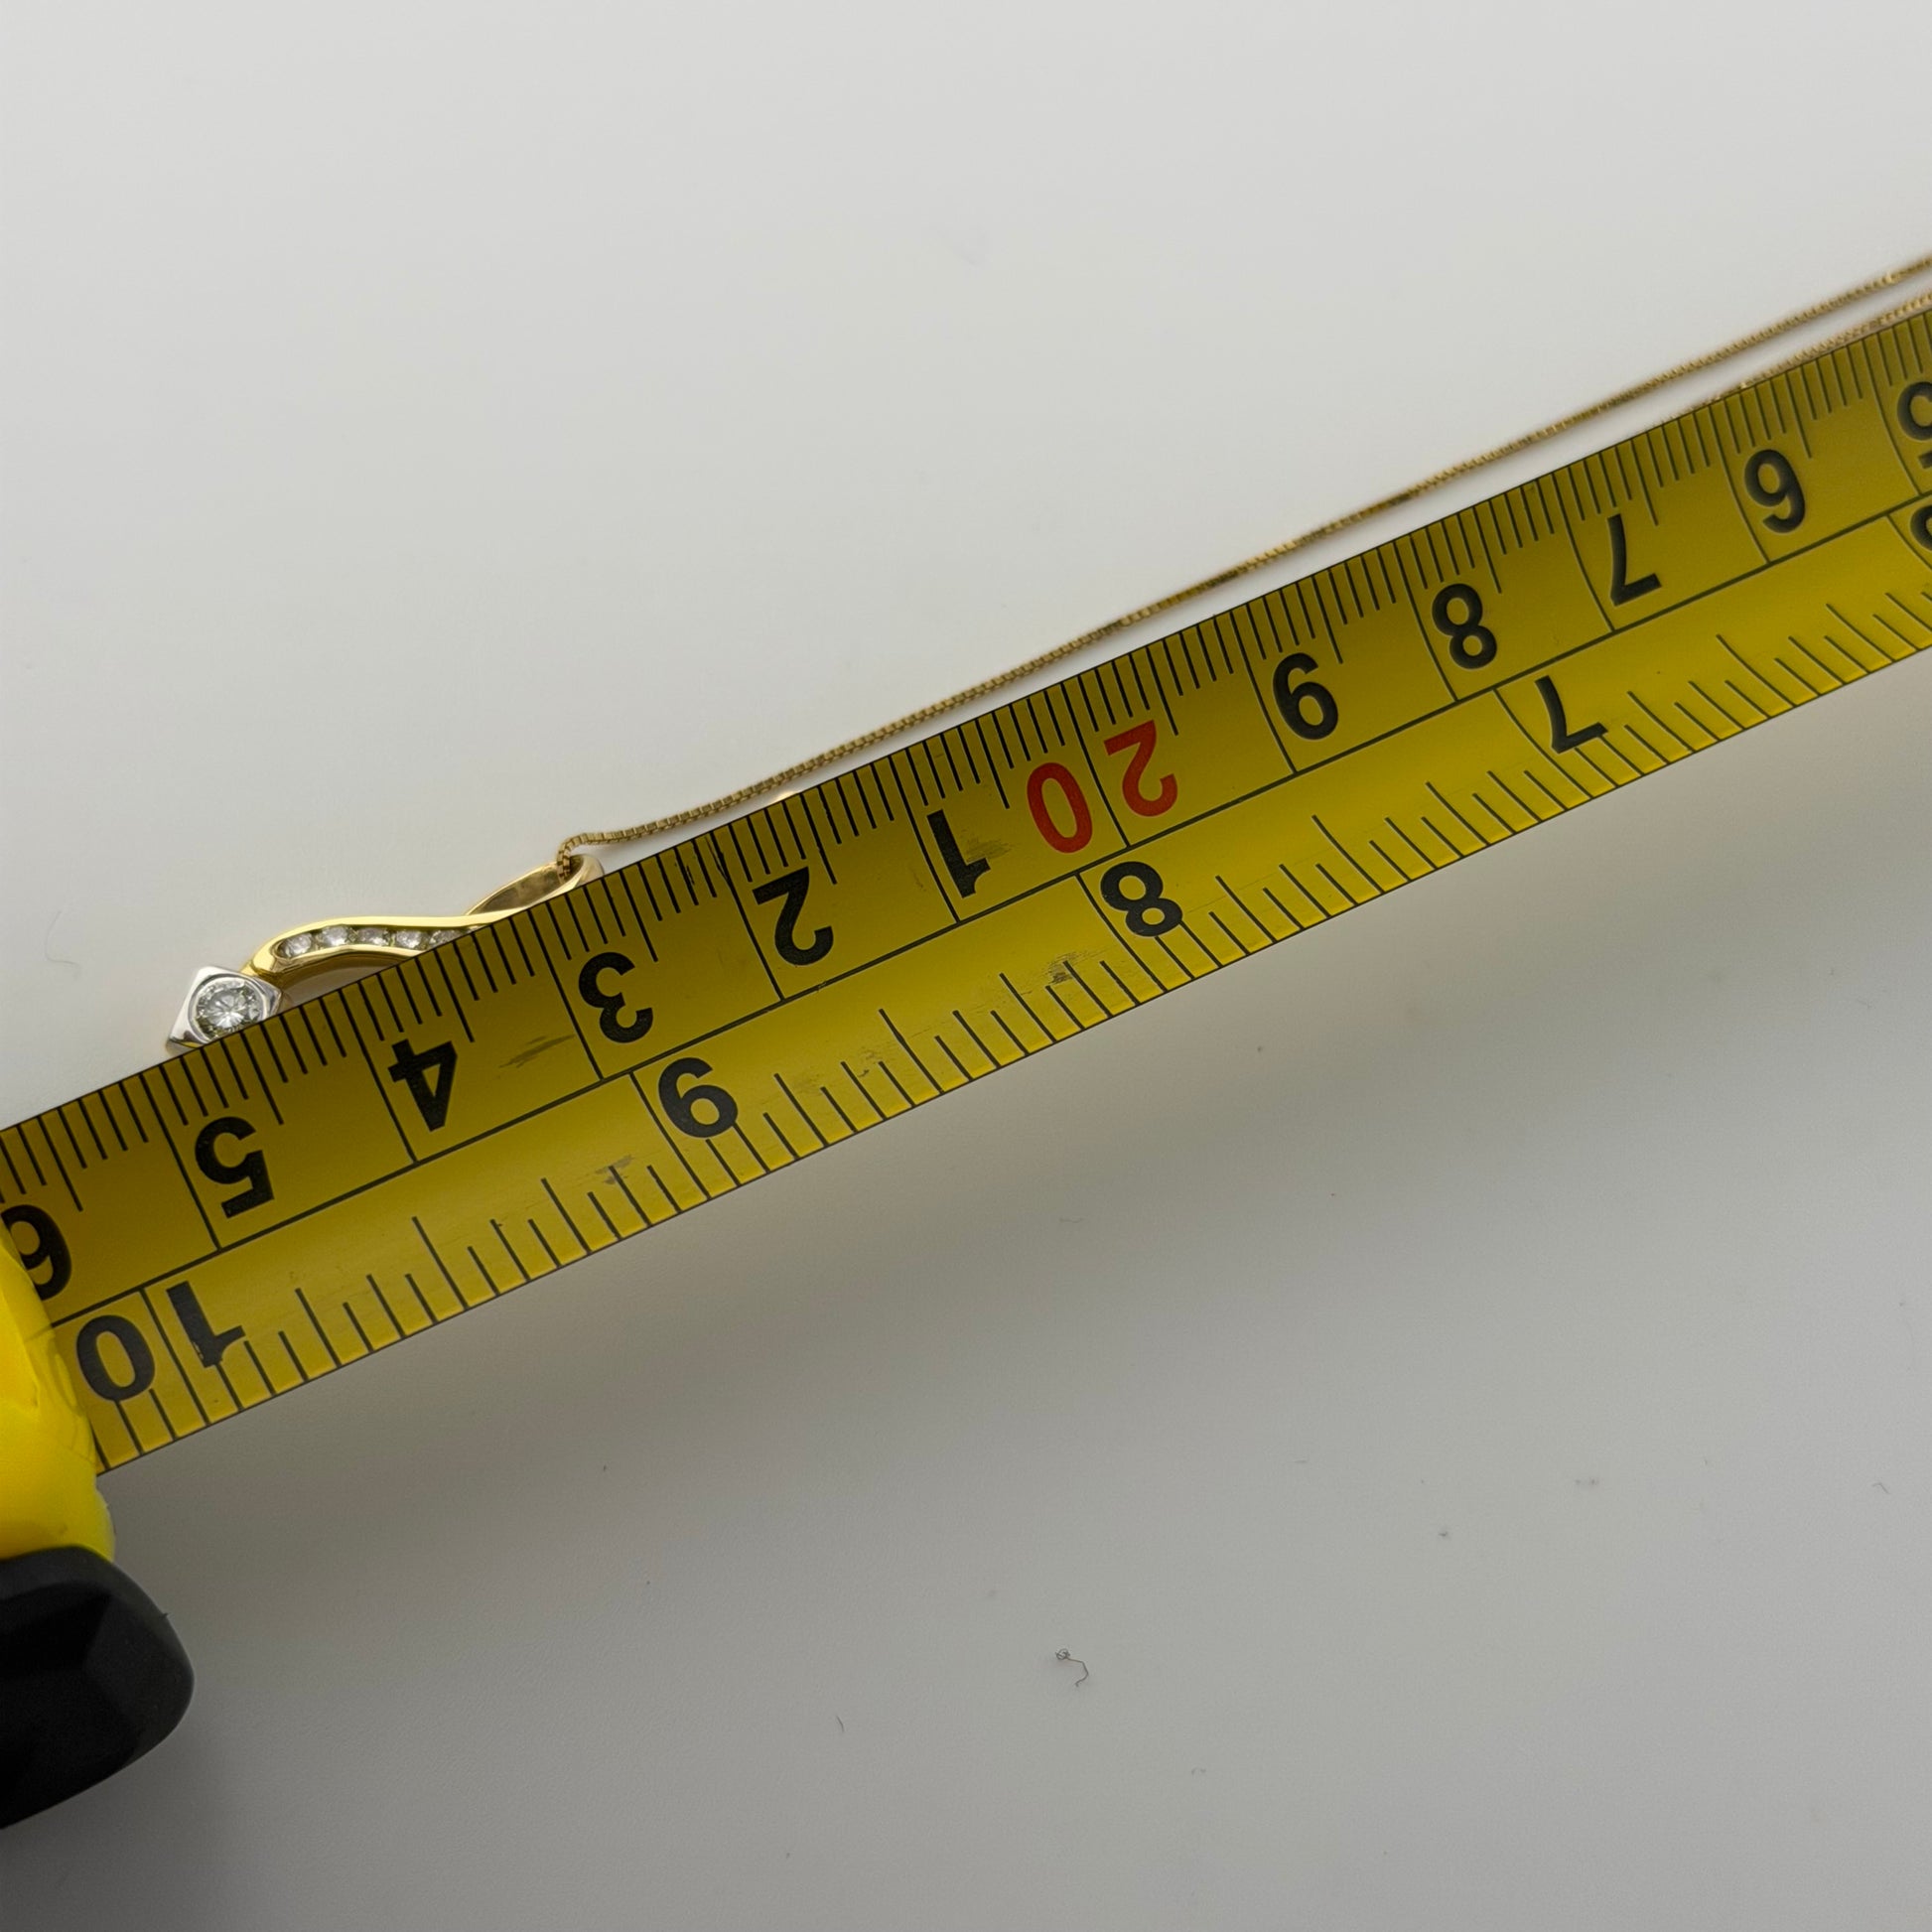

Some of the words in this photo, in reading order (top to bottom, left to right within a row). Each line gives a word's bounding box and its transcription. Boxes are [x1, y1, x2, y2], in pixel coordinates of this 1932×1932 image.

[1744, 449, 1806, 533] 6
[1606, 513, 1662, 607] 7
[1431, 583, 1498, 670] 8
[1272, 652, 1339, 740] 9
[1534, 675, 1609, 754] 7
[1026, 719, 1178, 854] 20
[925, 808, 991, 898] 1
[752, 866, 834, 966] 2
[1100, 861, 1183, 937] 8
[578, 951, 653, 1044] 3
[387, 1037, 458, 1133] 4
[657, 1056, 739, 1139] 9
[194, 1116, 275, 1219] 5
[75, 1281, 246, 1402] 10
